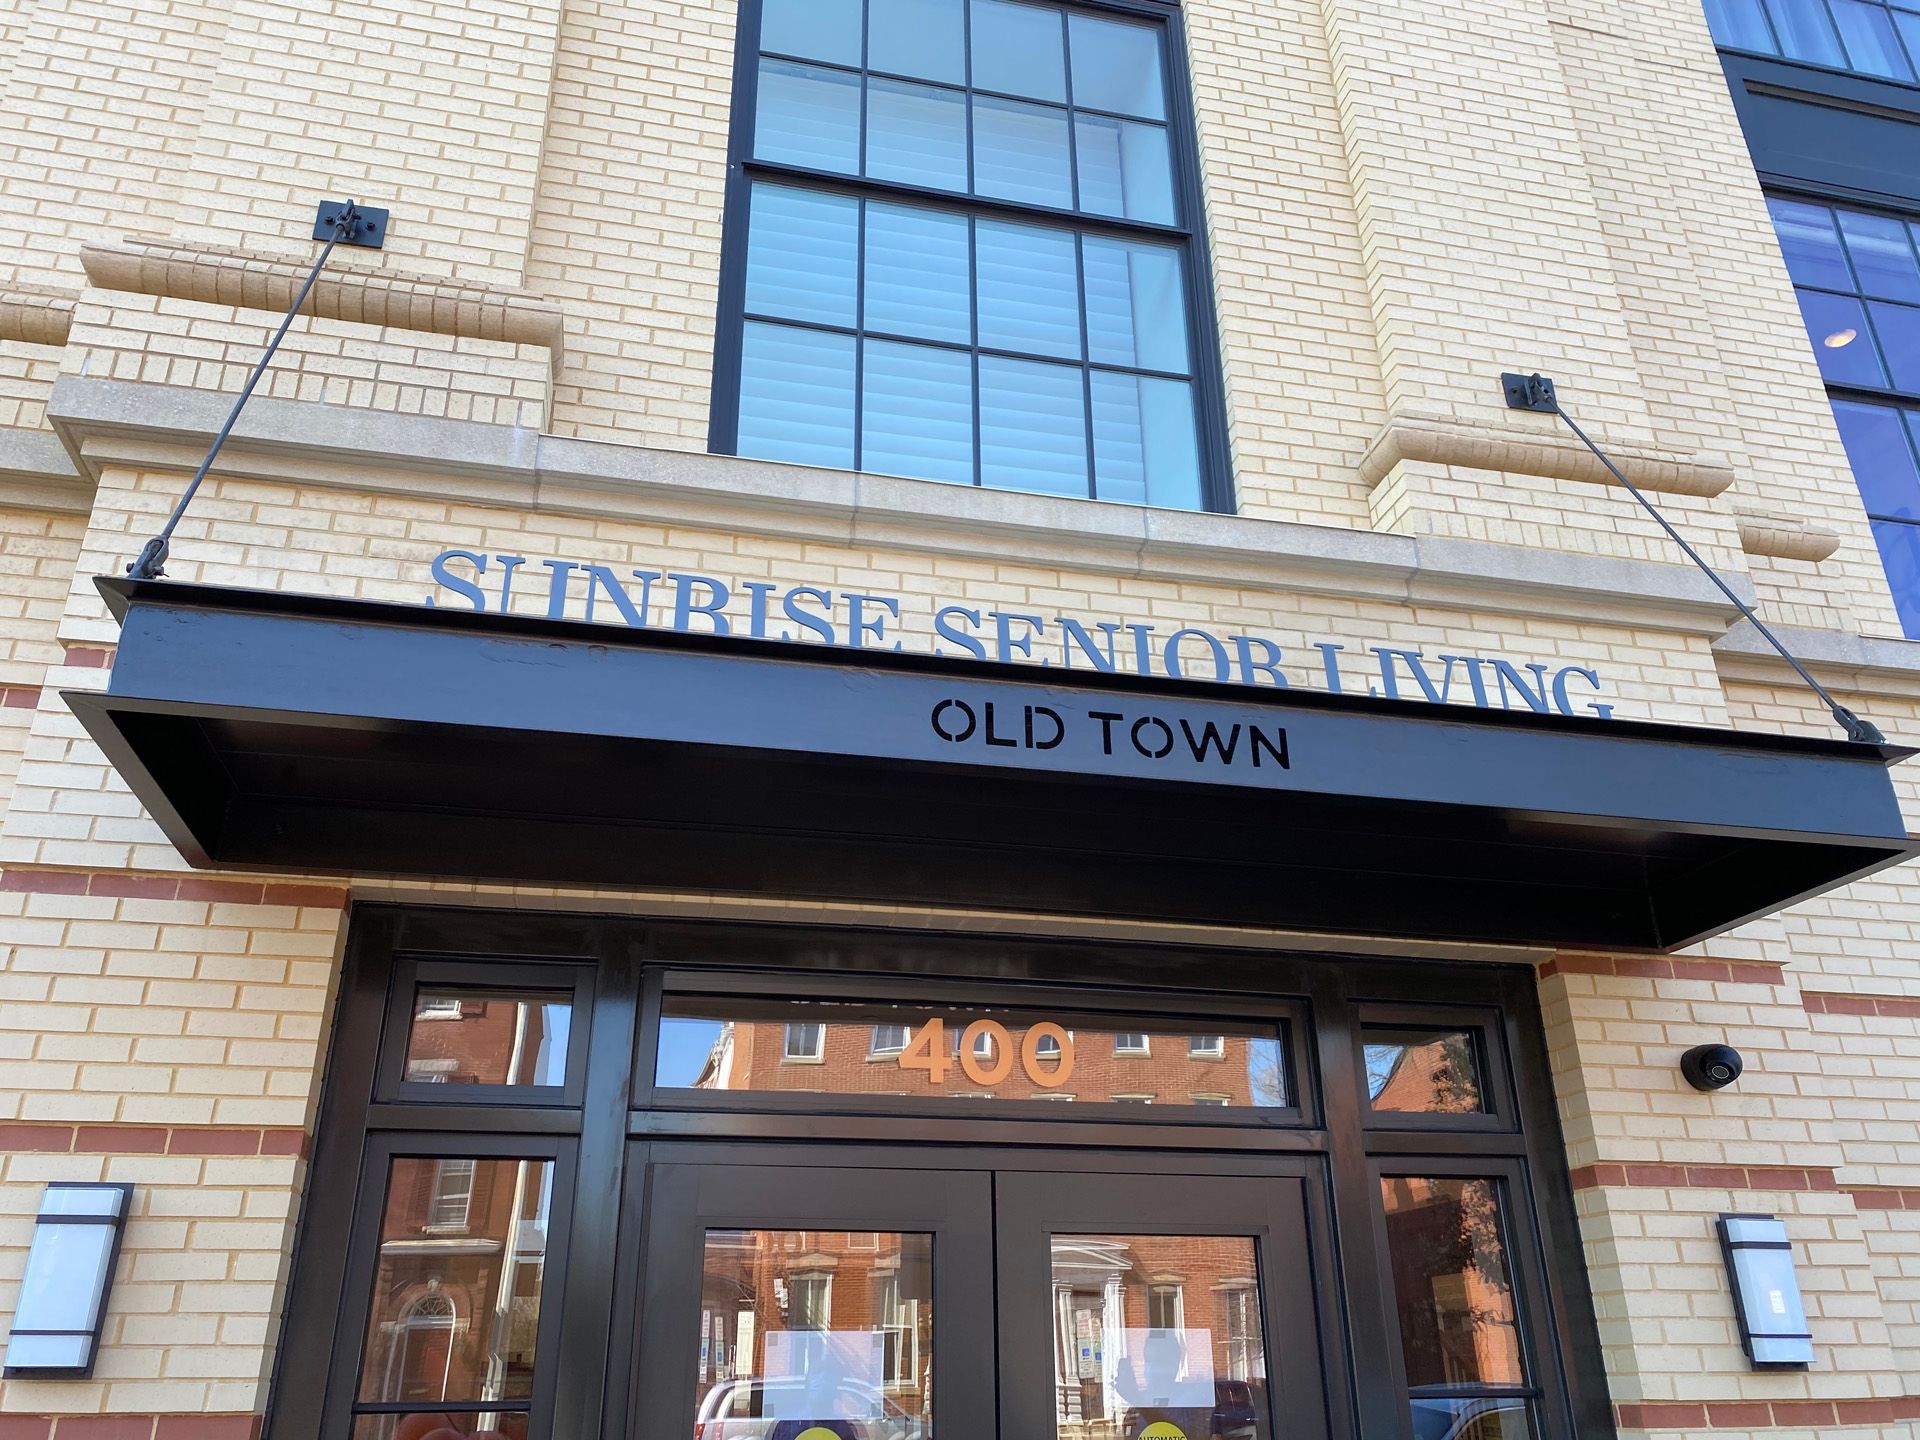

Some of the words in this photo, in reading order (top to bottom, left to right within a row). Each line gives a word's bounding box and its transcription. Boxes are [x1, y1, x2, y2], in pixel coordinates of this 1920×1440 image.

[426, 550, 902, 652] SUNRISE
[934, 606, 1289, 688] SENIOR
[1314, 643, 1615, 719] LIVING
[931, 699, 1065, 749] OLD
[1088, 711, 1290, 769] TOWN
[898, 1018, 1075, 1088] 400
